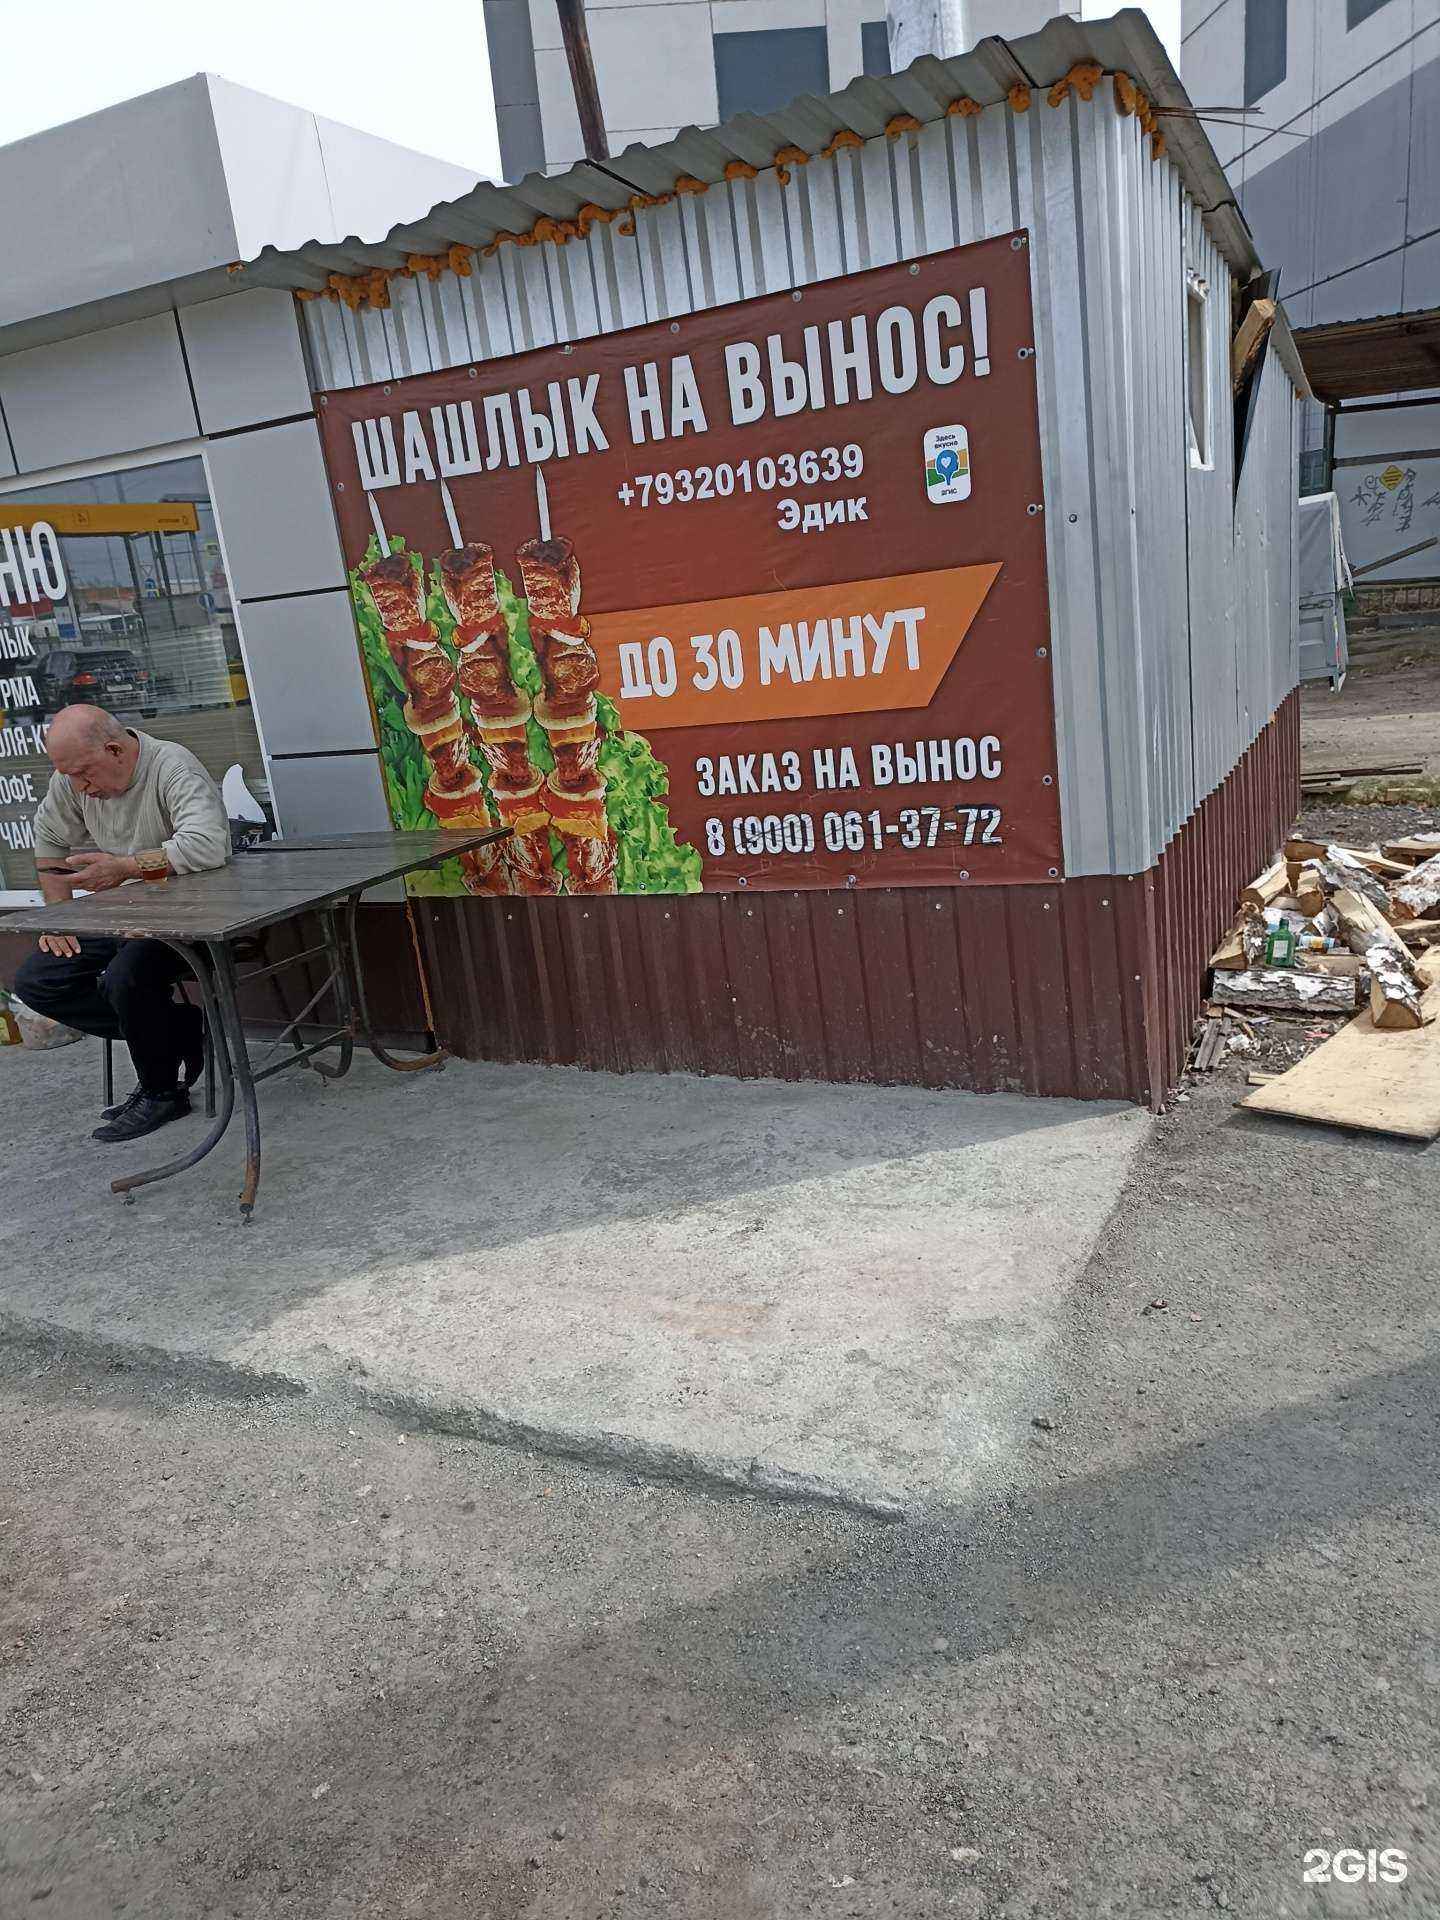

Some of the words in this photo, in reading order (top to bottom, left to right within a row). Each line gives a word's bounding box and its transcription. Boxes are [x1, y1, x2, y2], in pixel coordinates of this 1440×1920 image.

[350, 373, 610, 492] ШАШЛЫК
[623, 354, 709, 445] НА
[723, 286, 991, 427] ВЫНОС!
[617, 443, 866, 509] +79320103639
[776, 492, 869, 534] Эдик
[618, 636, 678, 699] ДО
[690, 628, 745, 692] 30
[758, 606, 926, 686] МИНУТ
[695, 750, 802, 796] ЗАКАЗ
[813, 746, 861, 790] НА
[870, 735, 1003, 786] ВЫНОС
[705, 817, 726, 857] 8
[732, 813, 815, 855] (900)
[823, 805, 1003, 852] 061-37-72
